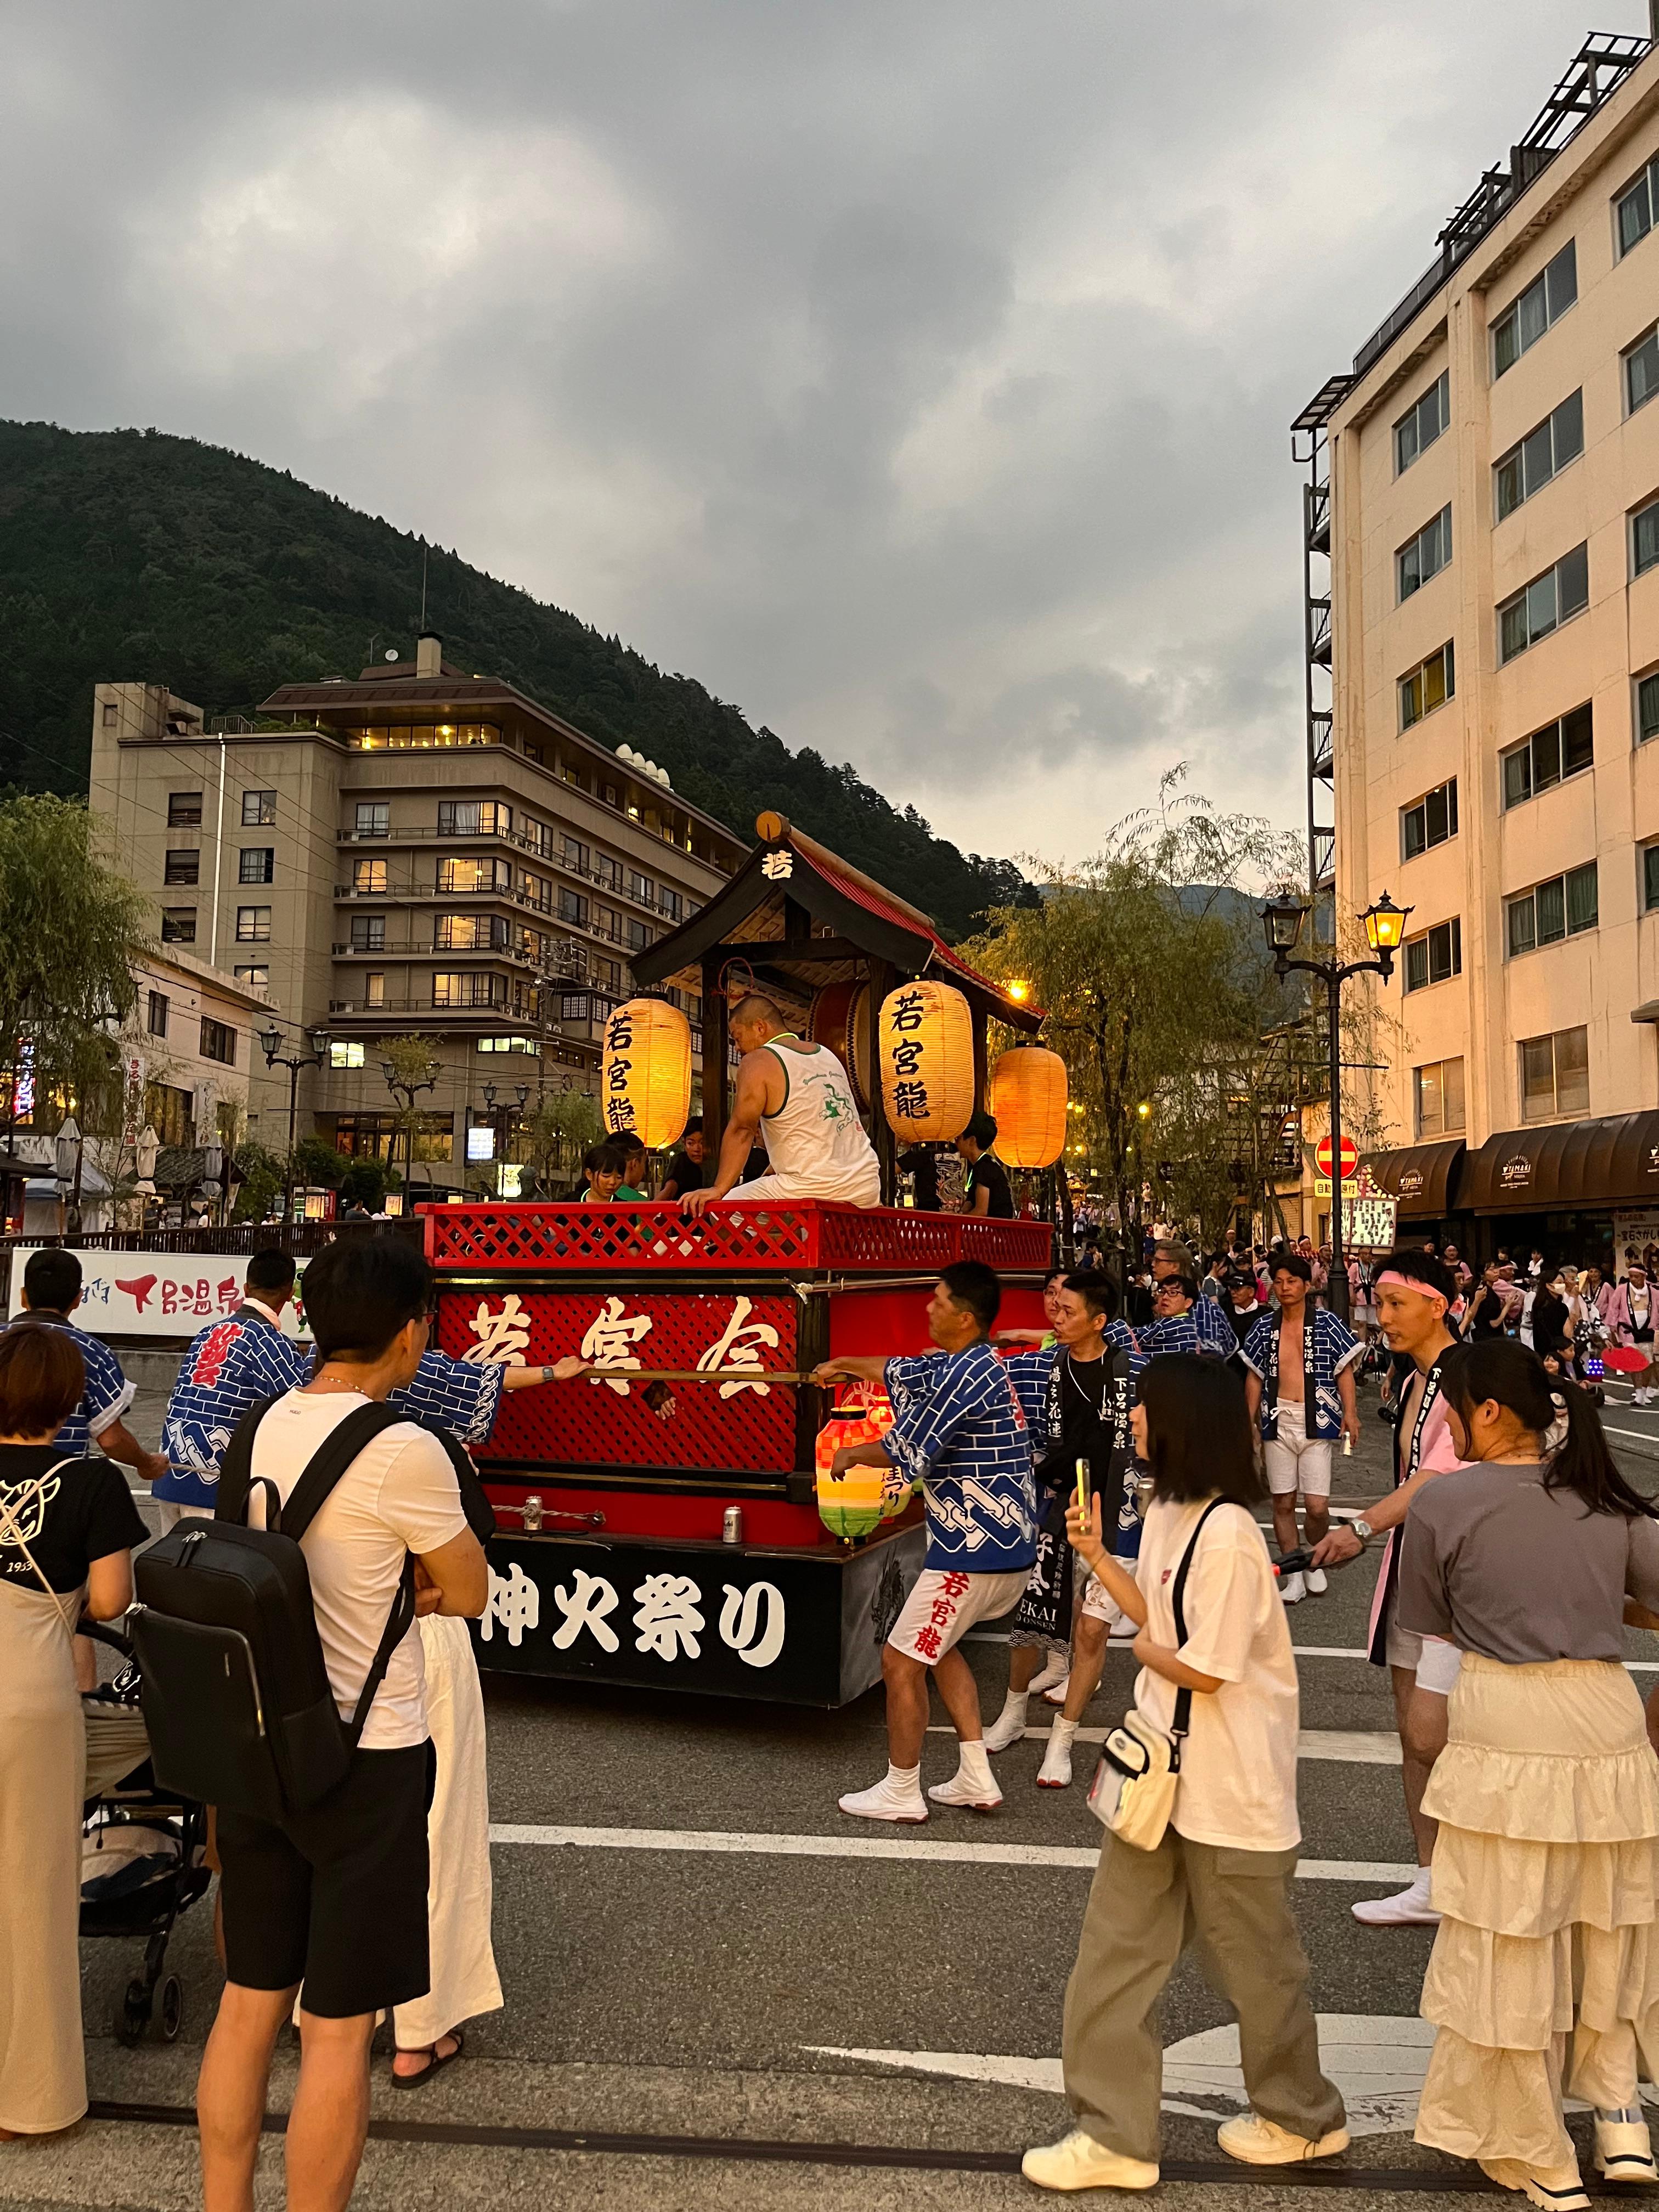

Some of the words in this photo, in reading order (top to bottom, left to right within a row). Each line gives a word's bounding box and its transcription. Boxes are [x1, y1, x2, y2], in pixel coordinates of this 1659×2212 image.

[606, 1011, 637, 1133] 若宮龍
[890, 990, 930, 1119] 若宮龍
[1318, 1183, 1355, 1194] 自動原付
[115, 1273, 245, 1316] 下呂温泉
[1304, 1327, 1314, 1373] 下呂温泉
[1048, 1366, 1062, 1437] 湯之花連
[1113, 1378, 1127, 1449] 下呂温泉
[884, 1466, 903, 1507] まつり
[1023, 1616, 1057, 1630] ONSEN
